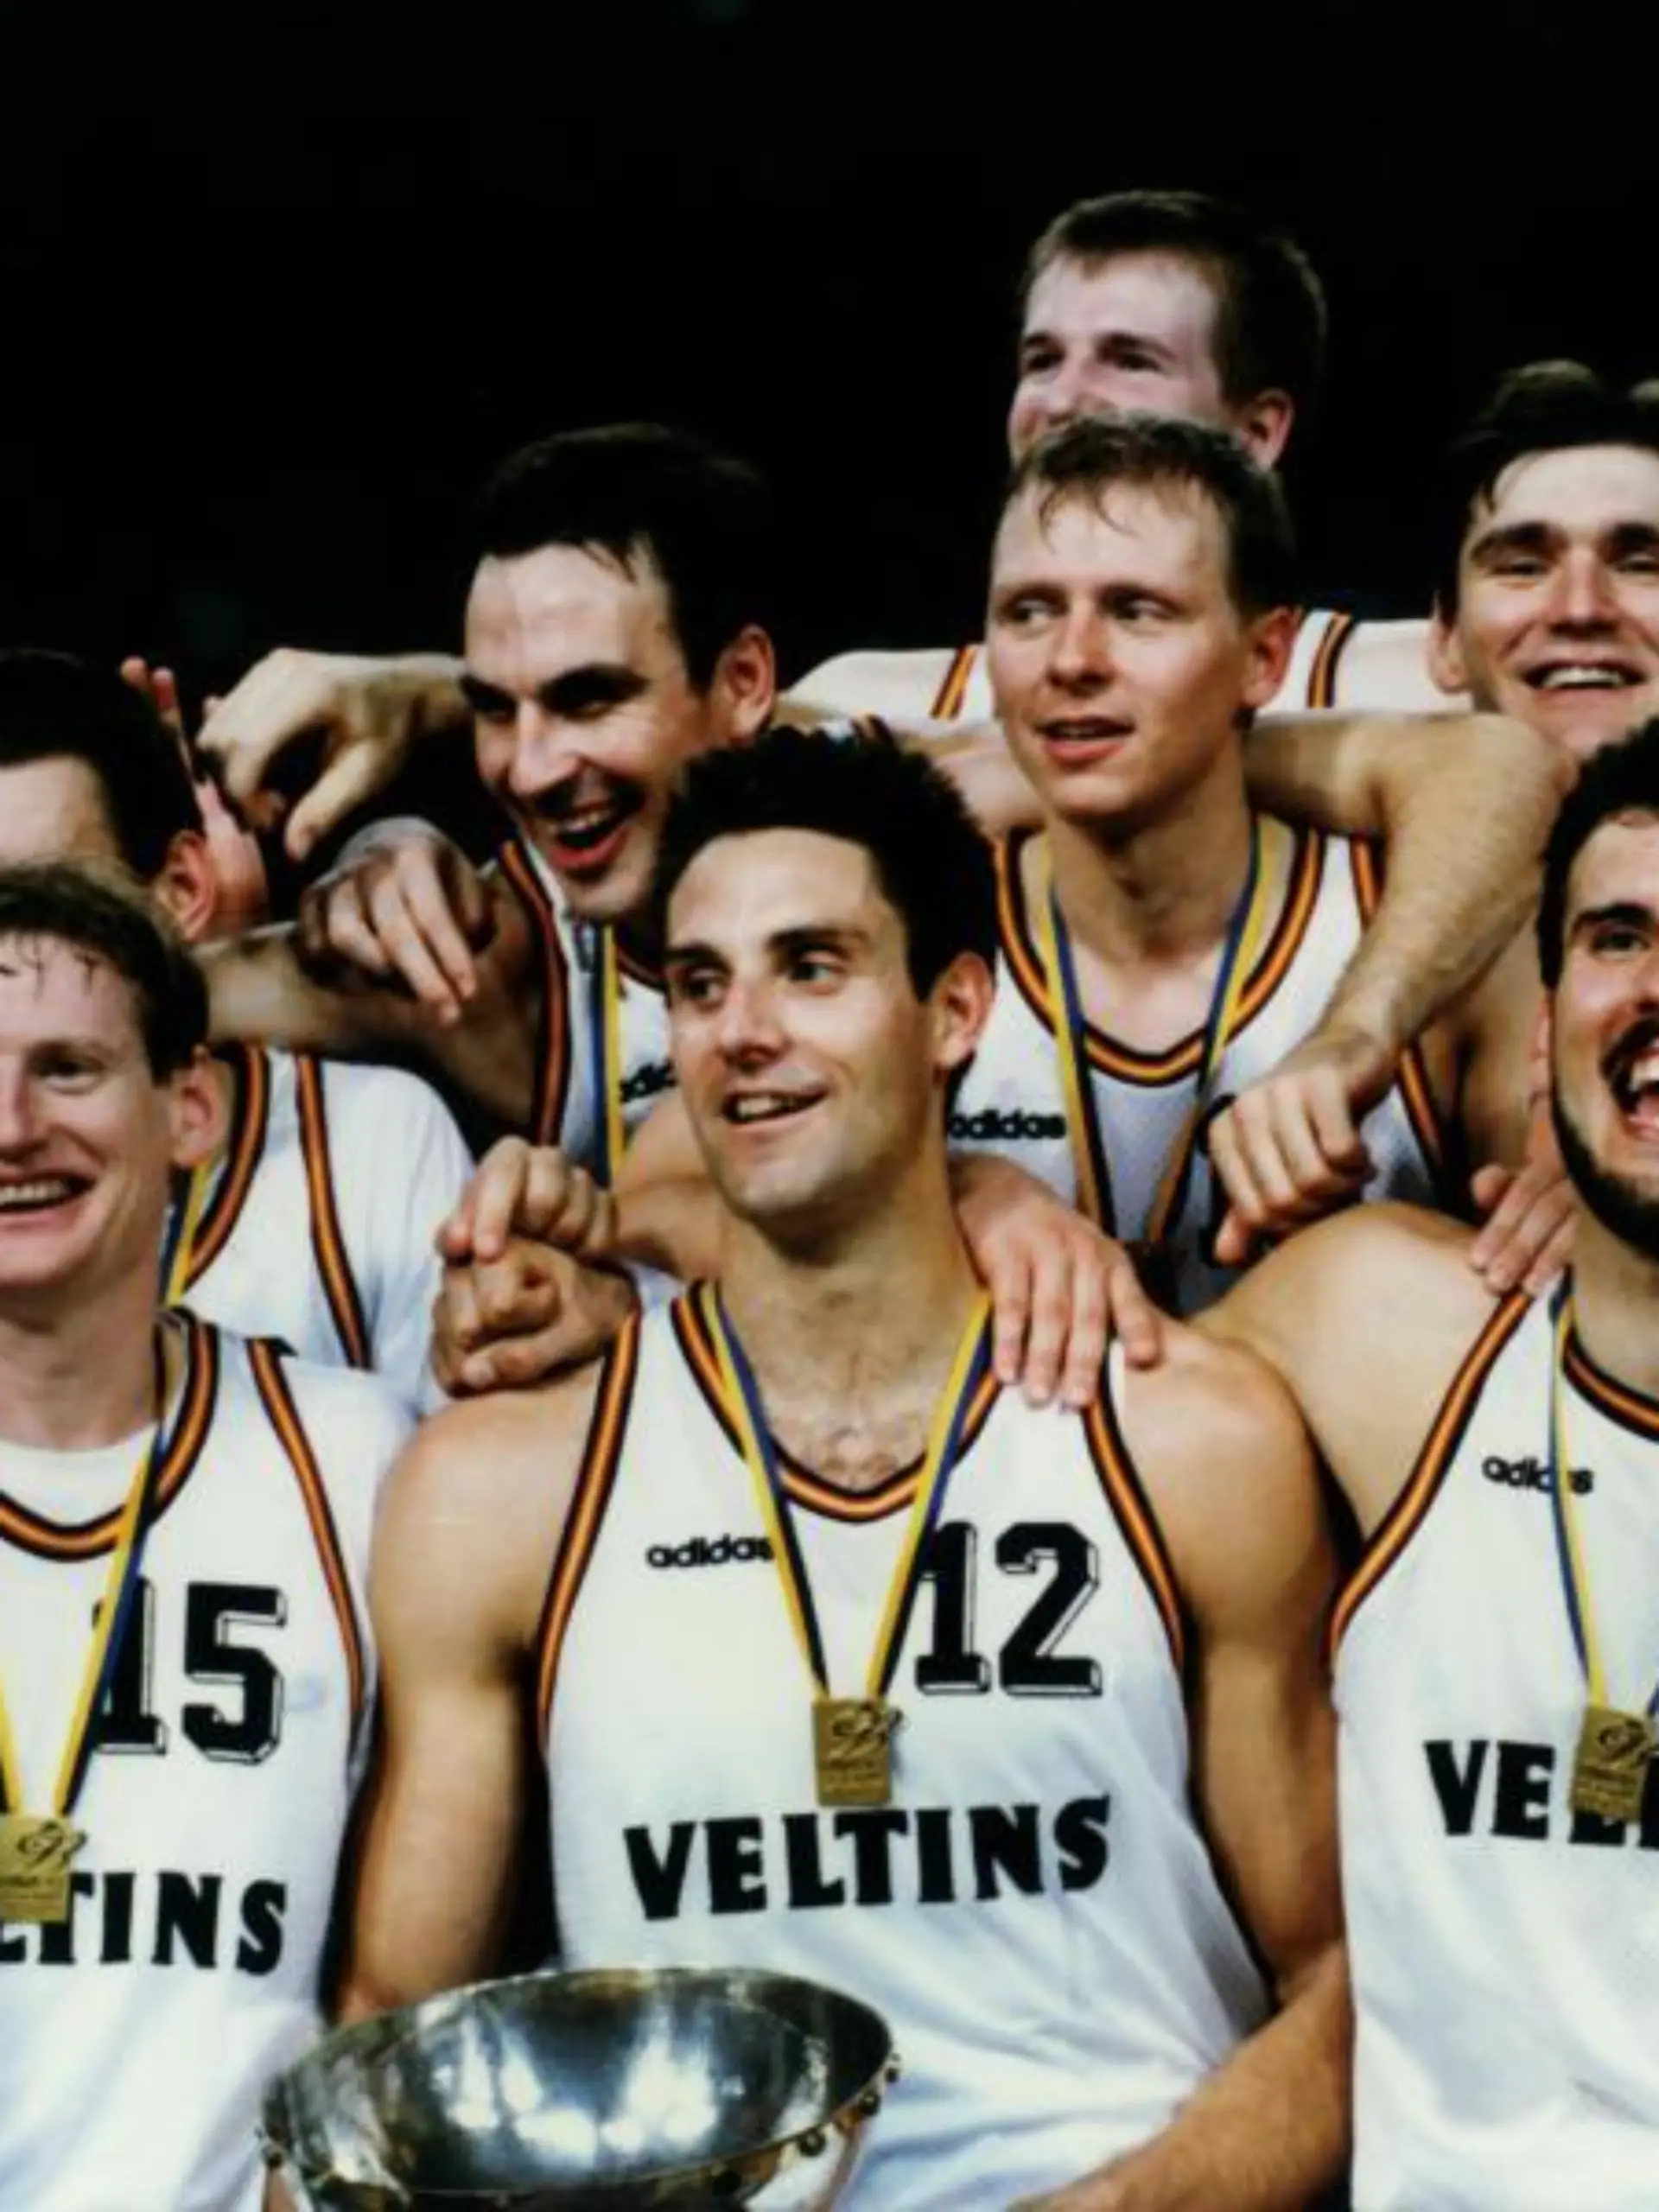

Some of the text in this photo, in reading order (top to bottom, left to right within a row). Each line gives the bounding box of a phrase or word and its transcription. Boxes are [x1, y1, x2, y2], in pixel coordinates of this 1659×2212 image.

[1481, 1455, 1594, 1495] adids
[92, 1574, 288, 1765] 15
[916, 1522, 1103, 1697] 12
[623, 1791, 1111, 1922] VELTINS
